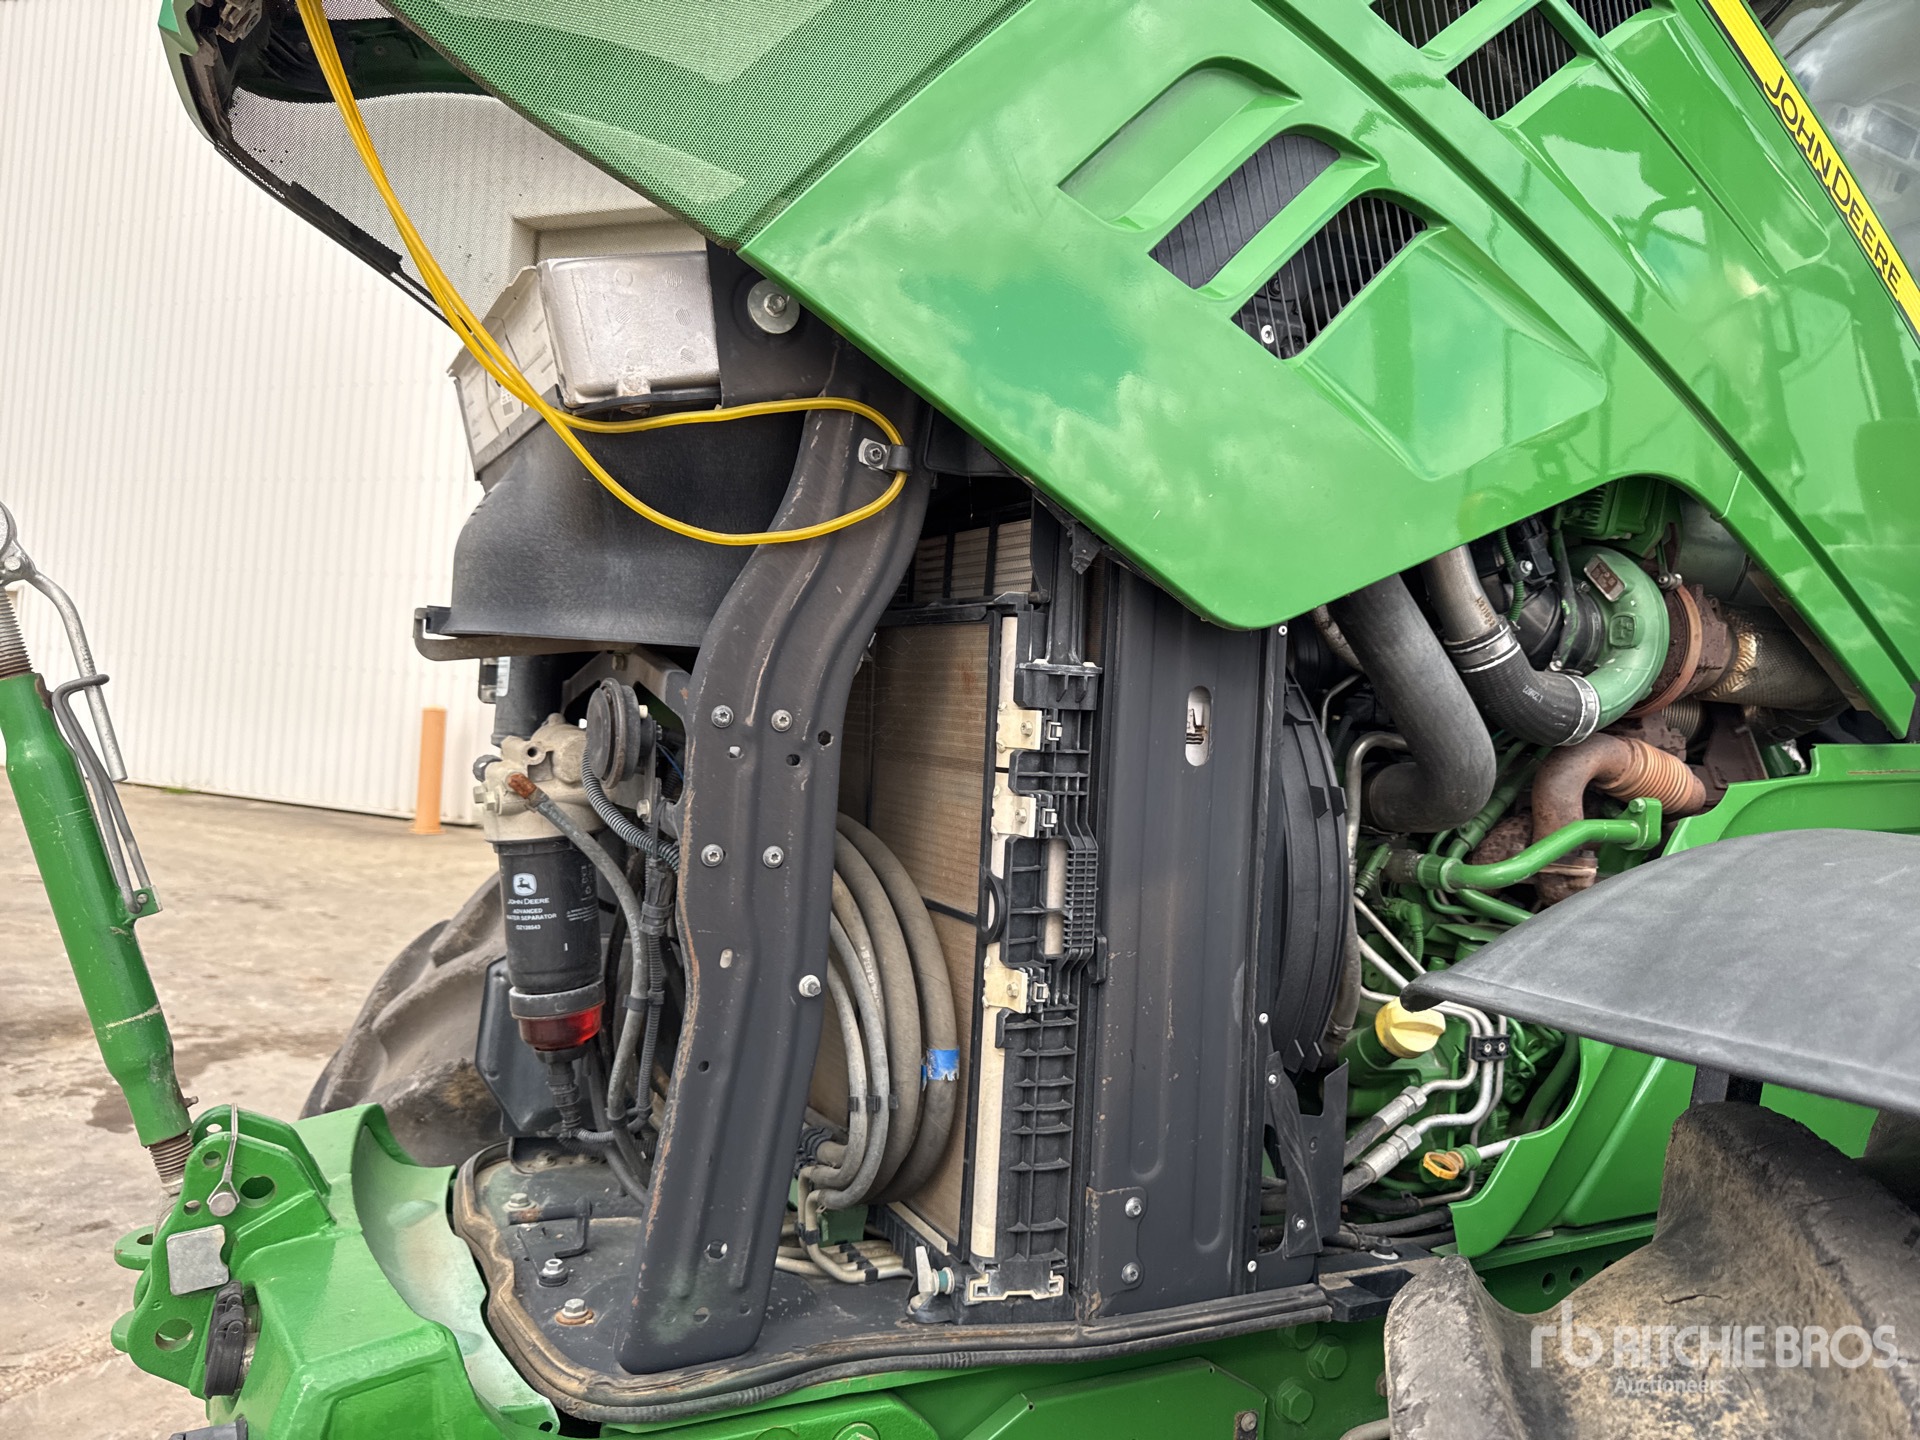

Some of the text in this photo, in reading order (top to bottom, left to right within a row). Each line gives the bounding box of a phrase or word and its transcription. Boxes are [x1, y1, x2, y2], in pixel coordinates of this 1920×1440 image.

[1764, 75, 1902, 294] JOHN DEERE
[523, 897, 550, 905] DEERE
[520, 912, 558, 921] SEPARATOR
